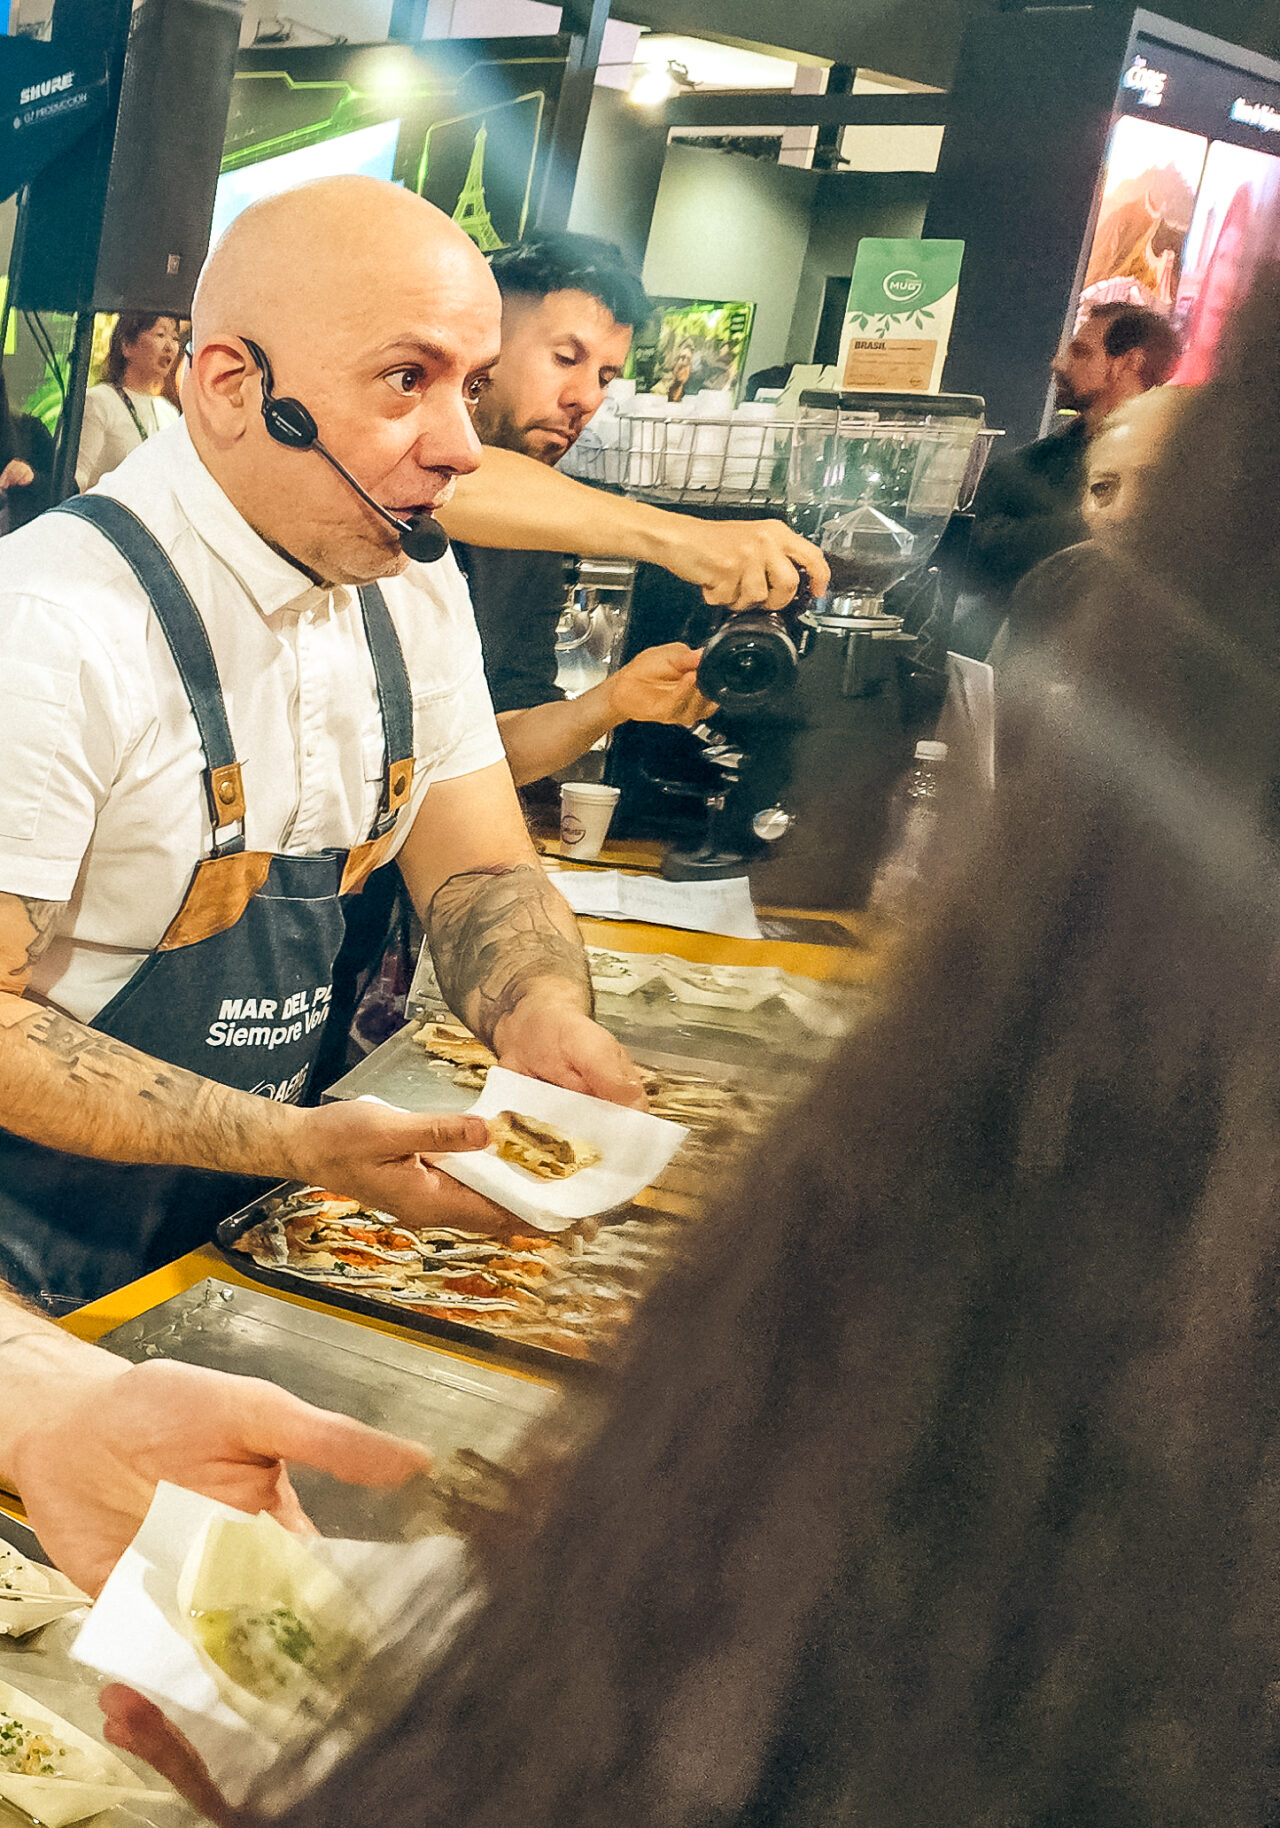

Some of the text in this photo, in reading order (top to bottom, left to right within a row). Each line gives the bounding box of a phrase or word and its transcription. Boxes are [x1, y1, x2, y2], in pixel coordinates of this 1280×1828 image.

[20, 71, 74, 105] SHURE
[218, 998, 278, 1020] MAR
[281, 990, 310, 1020] DEL
[205, 1021, 303, 1050] Siempre
